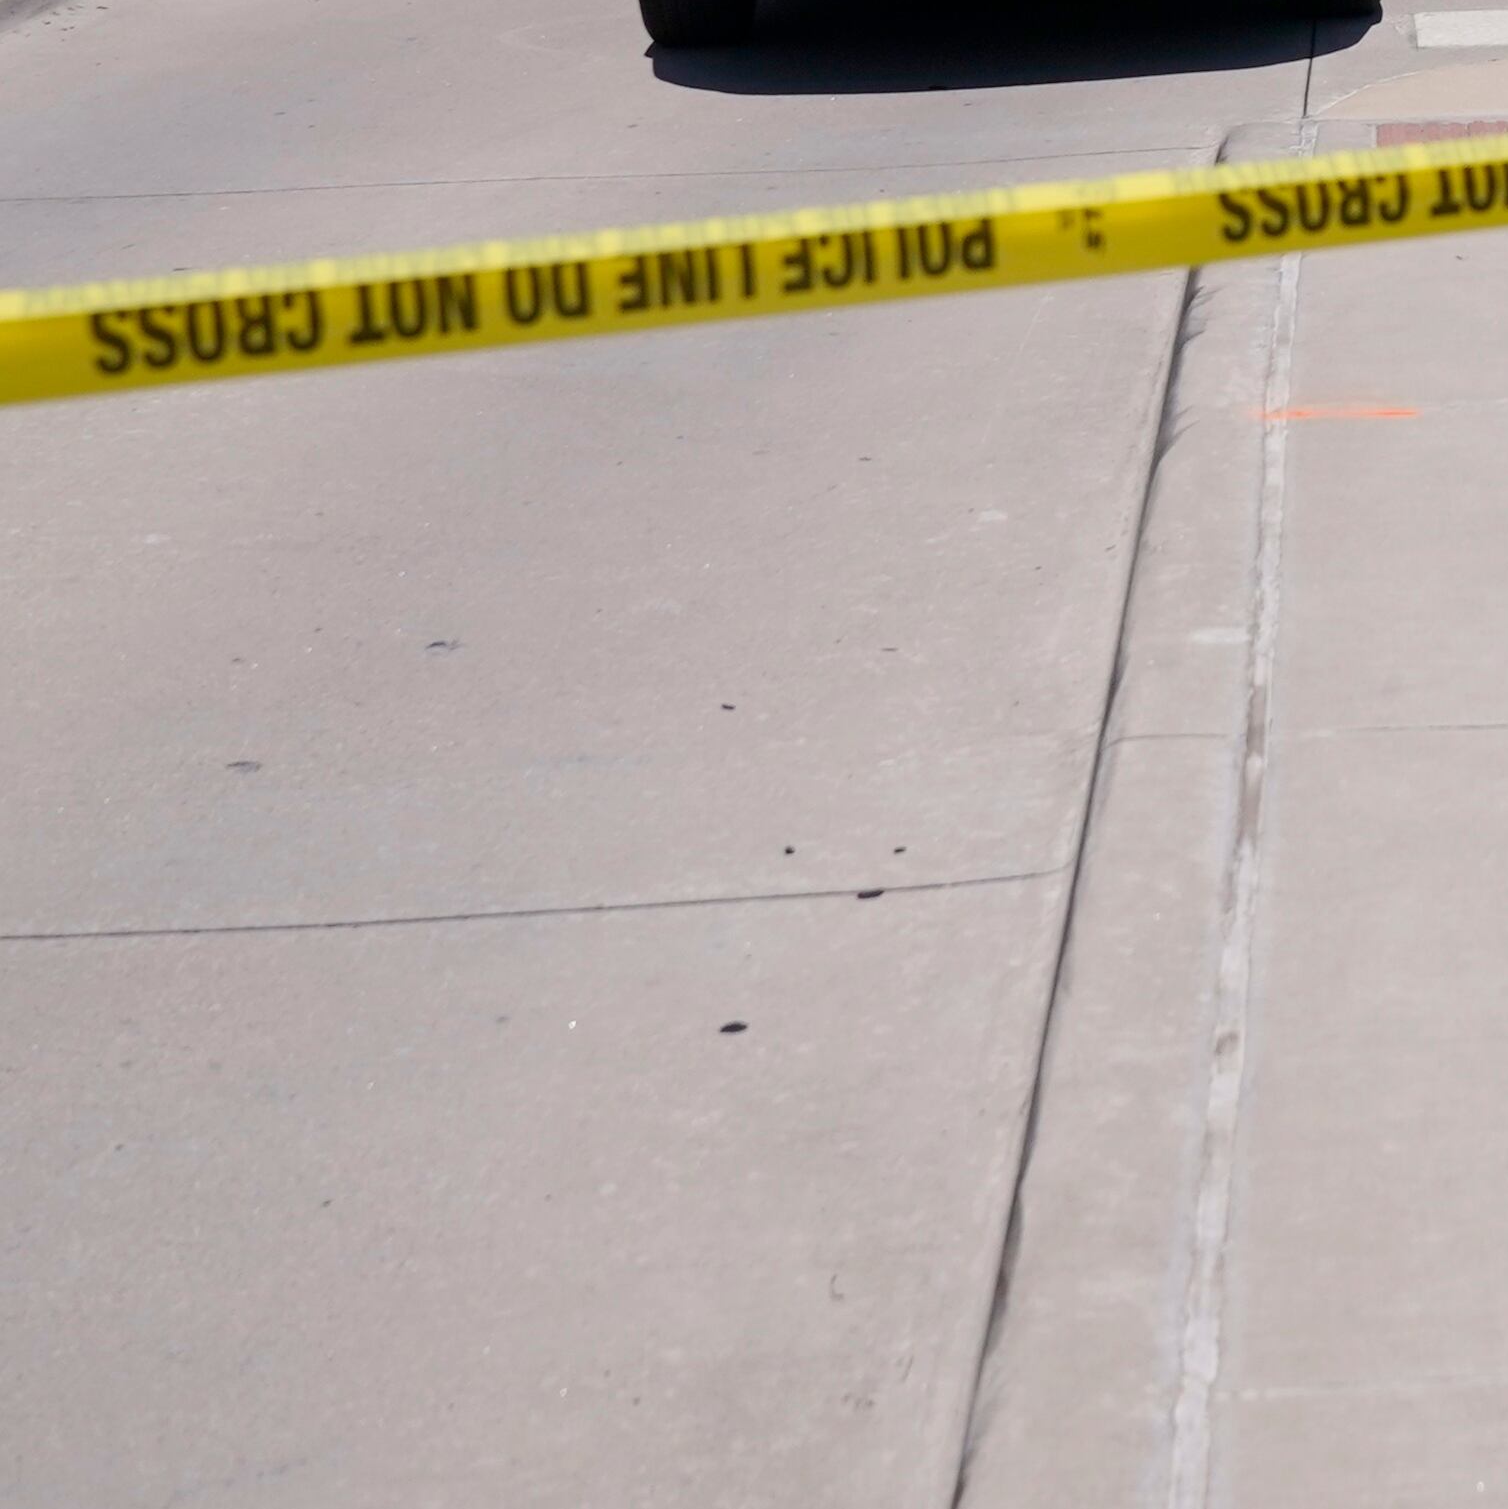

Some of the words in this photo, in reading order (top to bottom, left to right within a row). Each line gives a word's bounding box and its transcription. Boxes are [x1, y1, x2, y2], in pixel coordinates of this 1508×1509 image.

[1218, 172, 1410, 246] CROSS
[618, 242, 758, 316] LINE
[781, 214, 995, 294] POLICE
[348, 272, 482, 346] NOT
[504, 258, 590, 329] DO
[90, 290, 324, 378] CROSS
